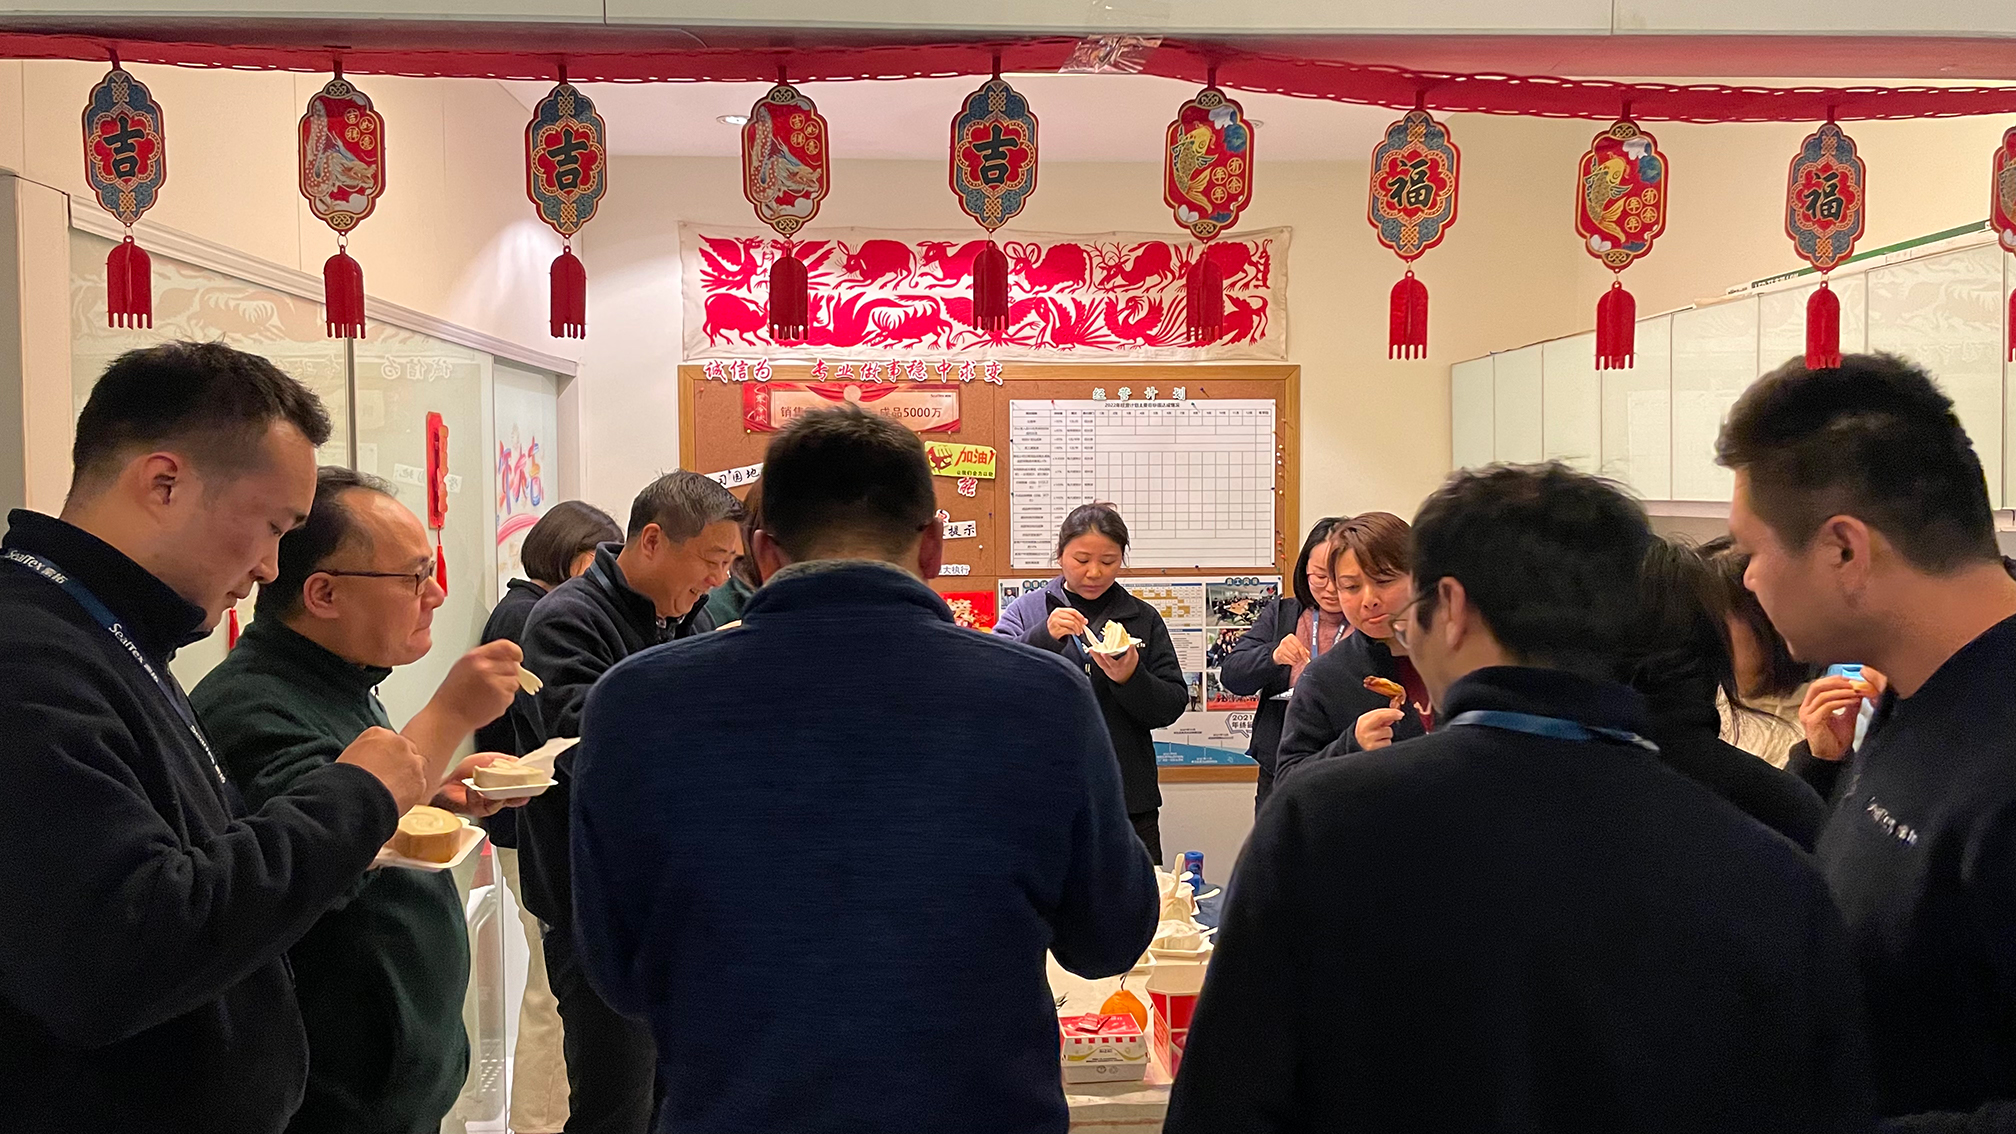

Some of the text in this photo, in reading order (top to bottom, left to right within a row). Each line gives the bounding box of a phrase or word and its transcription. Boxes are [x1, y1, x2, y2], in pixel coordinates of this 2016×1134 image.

[103, 116, 145, 178] 吉
[546, 129, 588, 191] 吉
[972, 125, 1018, 185] 吉
[1388, 159, 1434, 208] 福
[1804, 171, 1843, 221] 福
[704, 358, 771, 381] 诚信为
[880, 406, 942, 418] 成品5000万
[1092, 386, 1186, 400] 经营计划
[943, 524, 975, 537] 提示
[108, 623, 143, 664] SealTex
